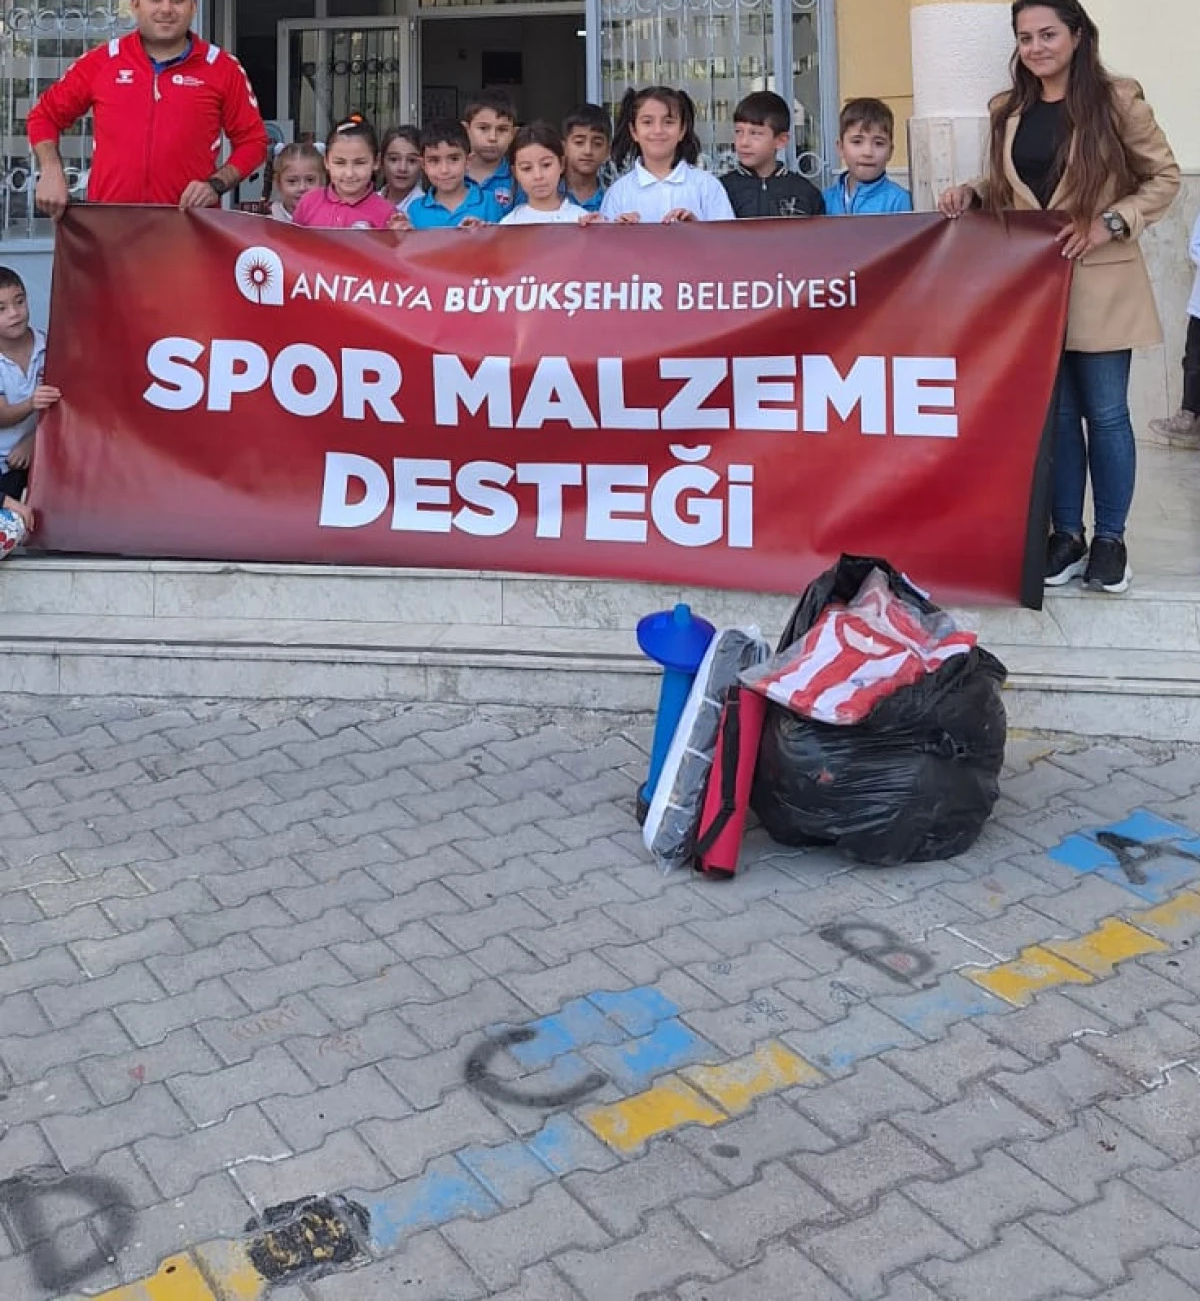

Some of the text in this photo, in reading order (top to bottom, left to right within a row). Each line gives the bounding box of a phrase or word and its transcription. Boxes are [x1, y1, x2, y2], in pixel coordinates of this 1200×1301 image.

[290, 270, 857, 317] ANTALYA BÜYÜKŞEHİR BELEDİYESİ
[142, 336, 959, 438] SPOR MALZEME
[1096, 831, 1200, 885] A
[818, 921, 936, 984] B
[464, 1027, 610, 1109] C
